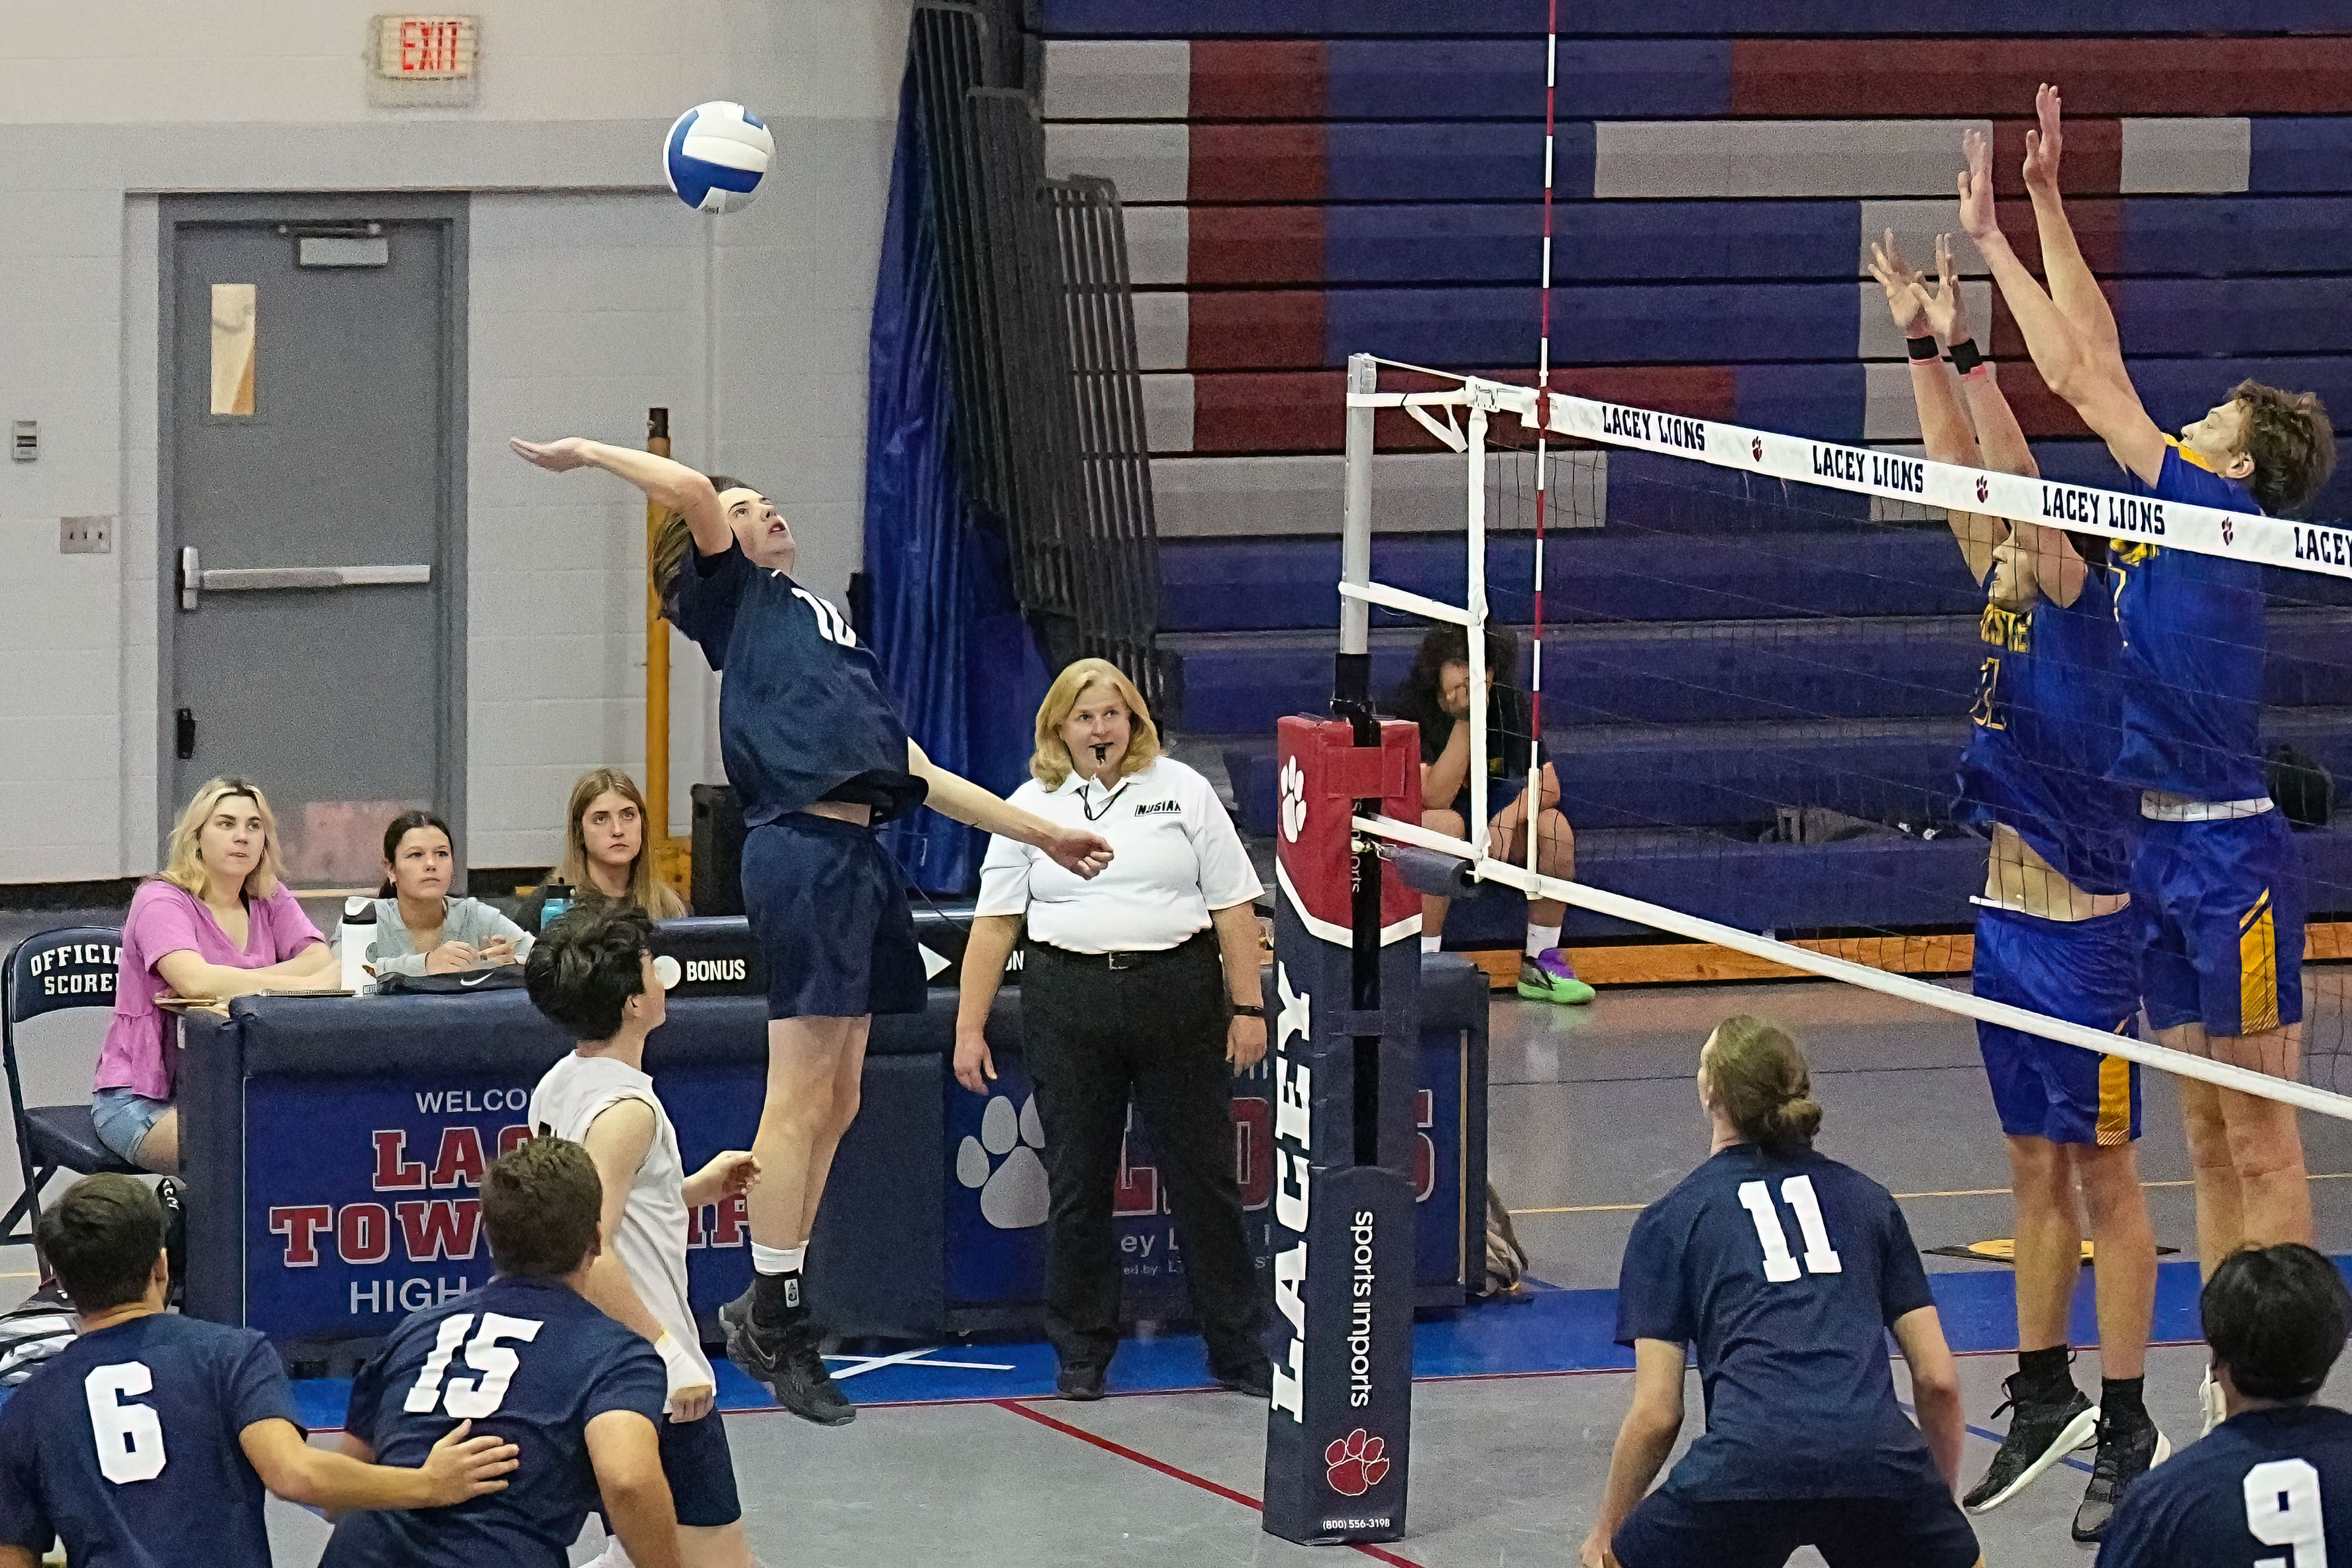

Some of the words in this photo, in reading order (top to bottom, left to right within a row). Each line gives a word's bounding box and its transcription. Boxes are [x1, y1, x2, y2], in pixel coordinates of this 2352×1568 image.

[401, 22, 462, 70] EXIT
[1602, 405, 1651, 441] LACEY
[1658, 415, 1705, 451] LIONS
[1813, 444, 1865, 483] LACEY
[1873, 456, 1923, 494] LIONS
[2043, 485, 2100, 525] LACEY
[2109, 496, 2165, 535] LIONS
[2294, 526, 2352, 568] LACEY
[30, 943, 123, 976] OFFICI
[44, 972, 119, 995] SCORE
[686, 959, 746, 982] BONUS
[415, 1088, 533, 1114] WELCO
[1271, 960, 1310, 1424] LACEY
[1738, 1175, 1842, 1282] 11
[1350, 1211, 1375, 1297] sports
[350, 1276, 466, 1314] HIGH
[403, 1312, 544, 1418] 15
[1347, 1301, 1373, 1407] imports
[84, 1361, 166, 1485] 6
[1323, 1520, 1346, 1531] (800)
[1348, 1518, 1390, 1528] 556-3198
[2243, 1457, 2328, 1568] 9
